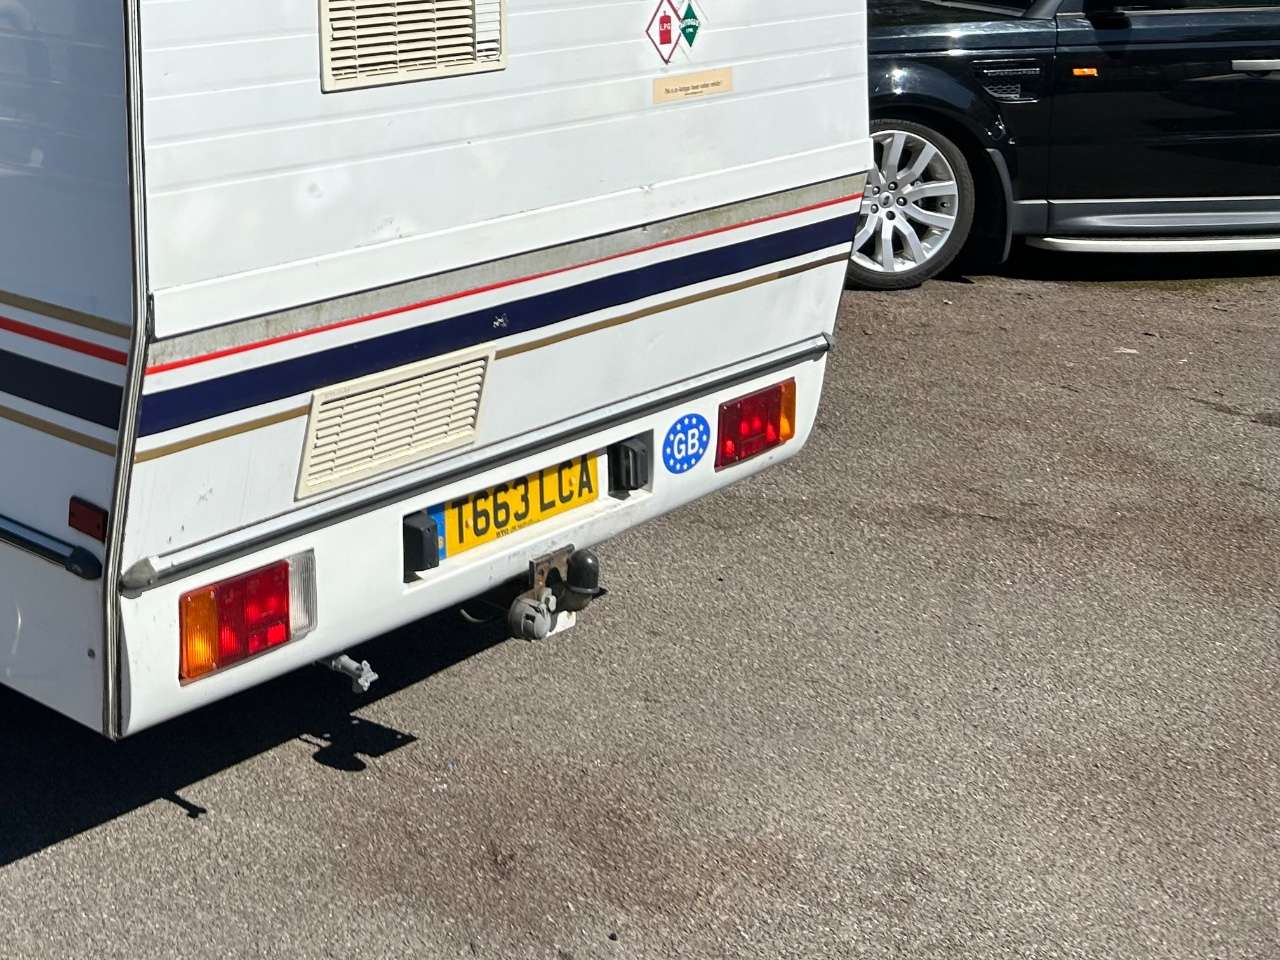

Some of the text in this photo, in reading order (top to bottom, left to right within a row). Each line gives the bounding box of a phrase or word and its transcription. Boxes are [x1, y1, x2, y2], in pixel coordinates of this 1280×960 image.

[673, 427, 700, 460] GB
[451, 453, 594, 545] T663 LCA
